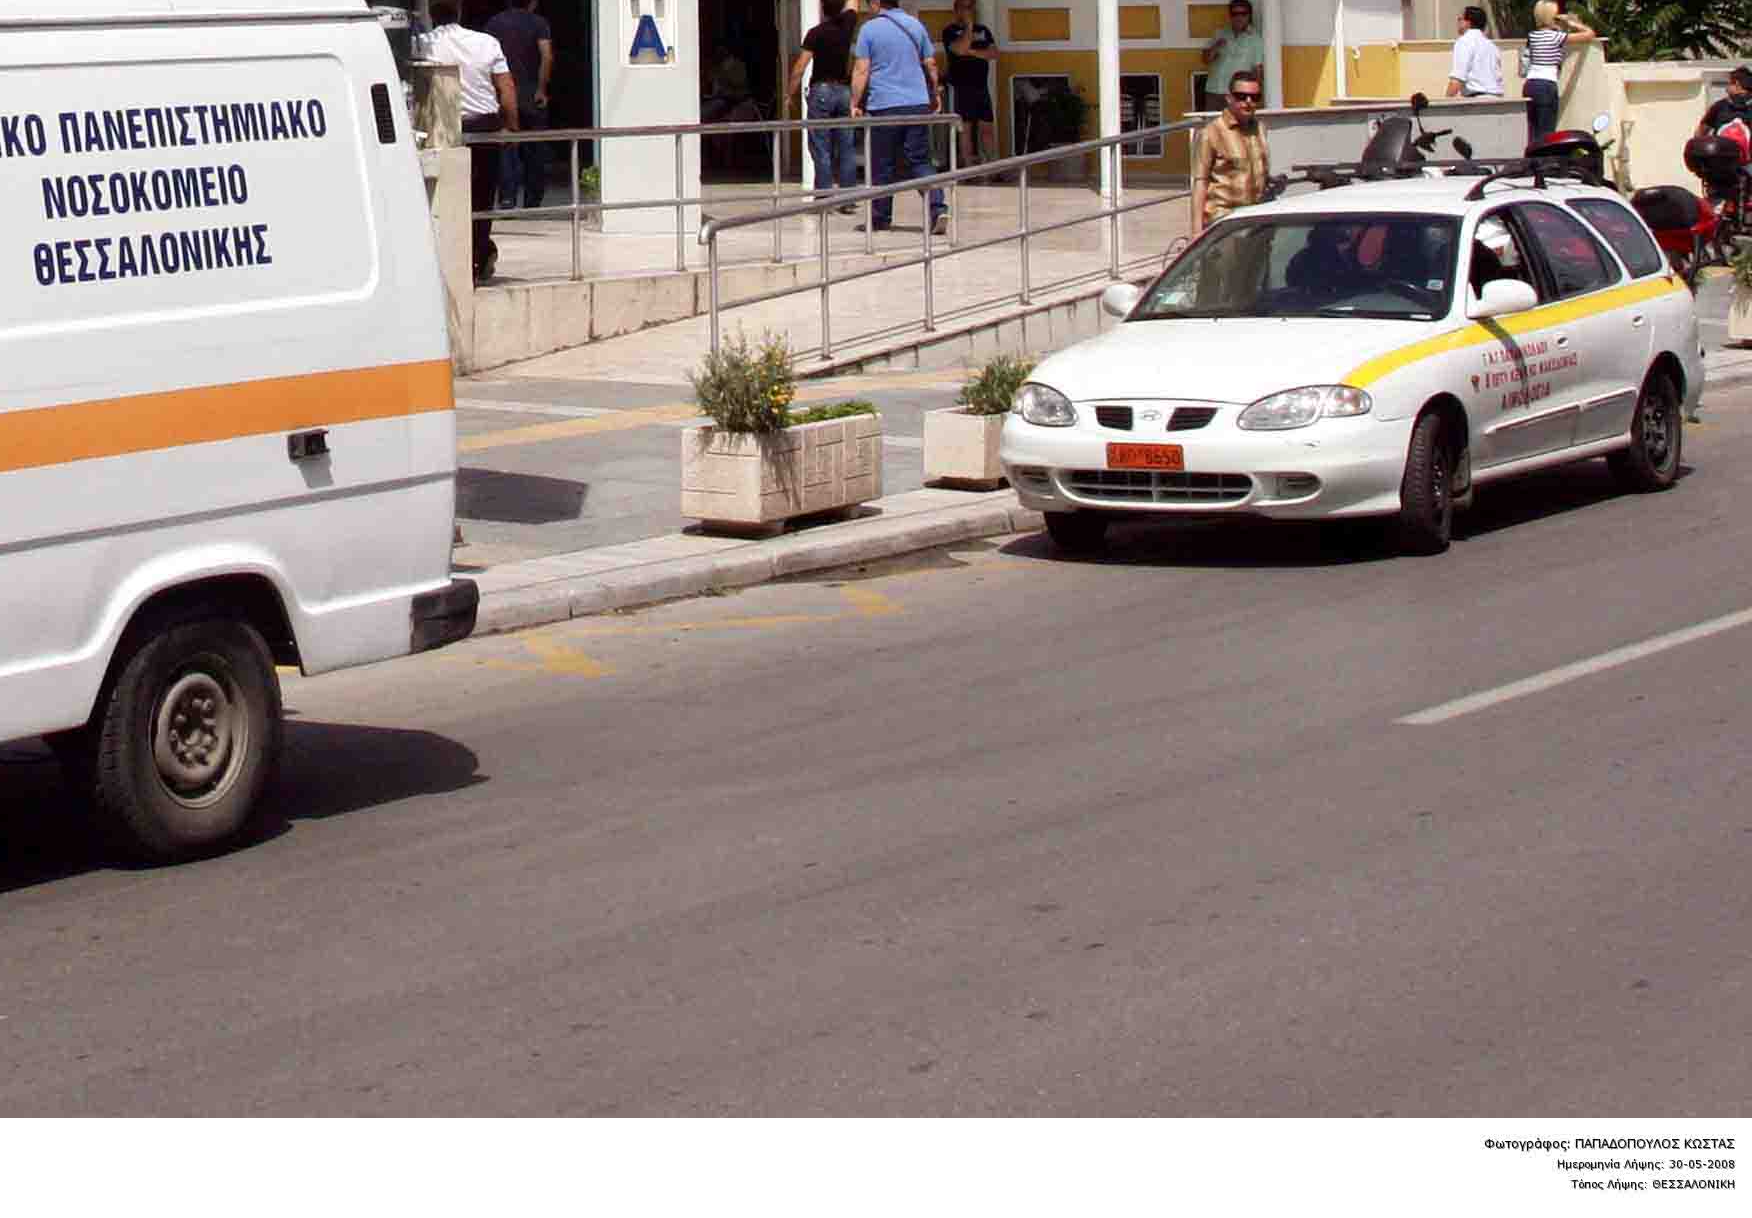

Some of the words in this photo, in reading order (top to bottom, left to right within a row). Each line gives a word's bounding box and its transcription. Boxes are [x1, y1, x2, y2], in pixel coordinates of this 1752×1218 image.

[59, 99, 326, 153] ΠΑΝΕΠΙΣΤΗΜΙΑΚΟ
[42, 164, 248, 219] ΝΟΣΟΚΟΜΕΙΟ
[34, 225, 272, 286] ΘΕΣΣΑΛΟΝΙΚΗΣ
